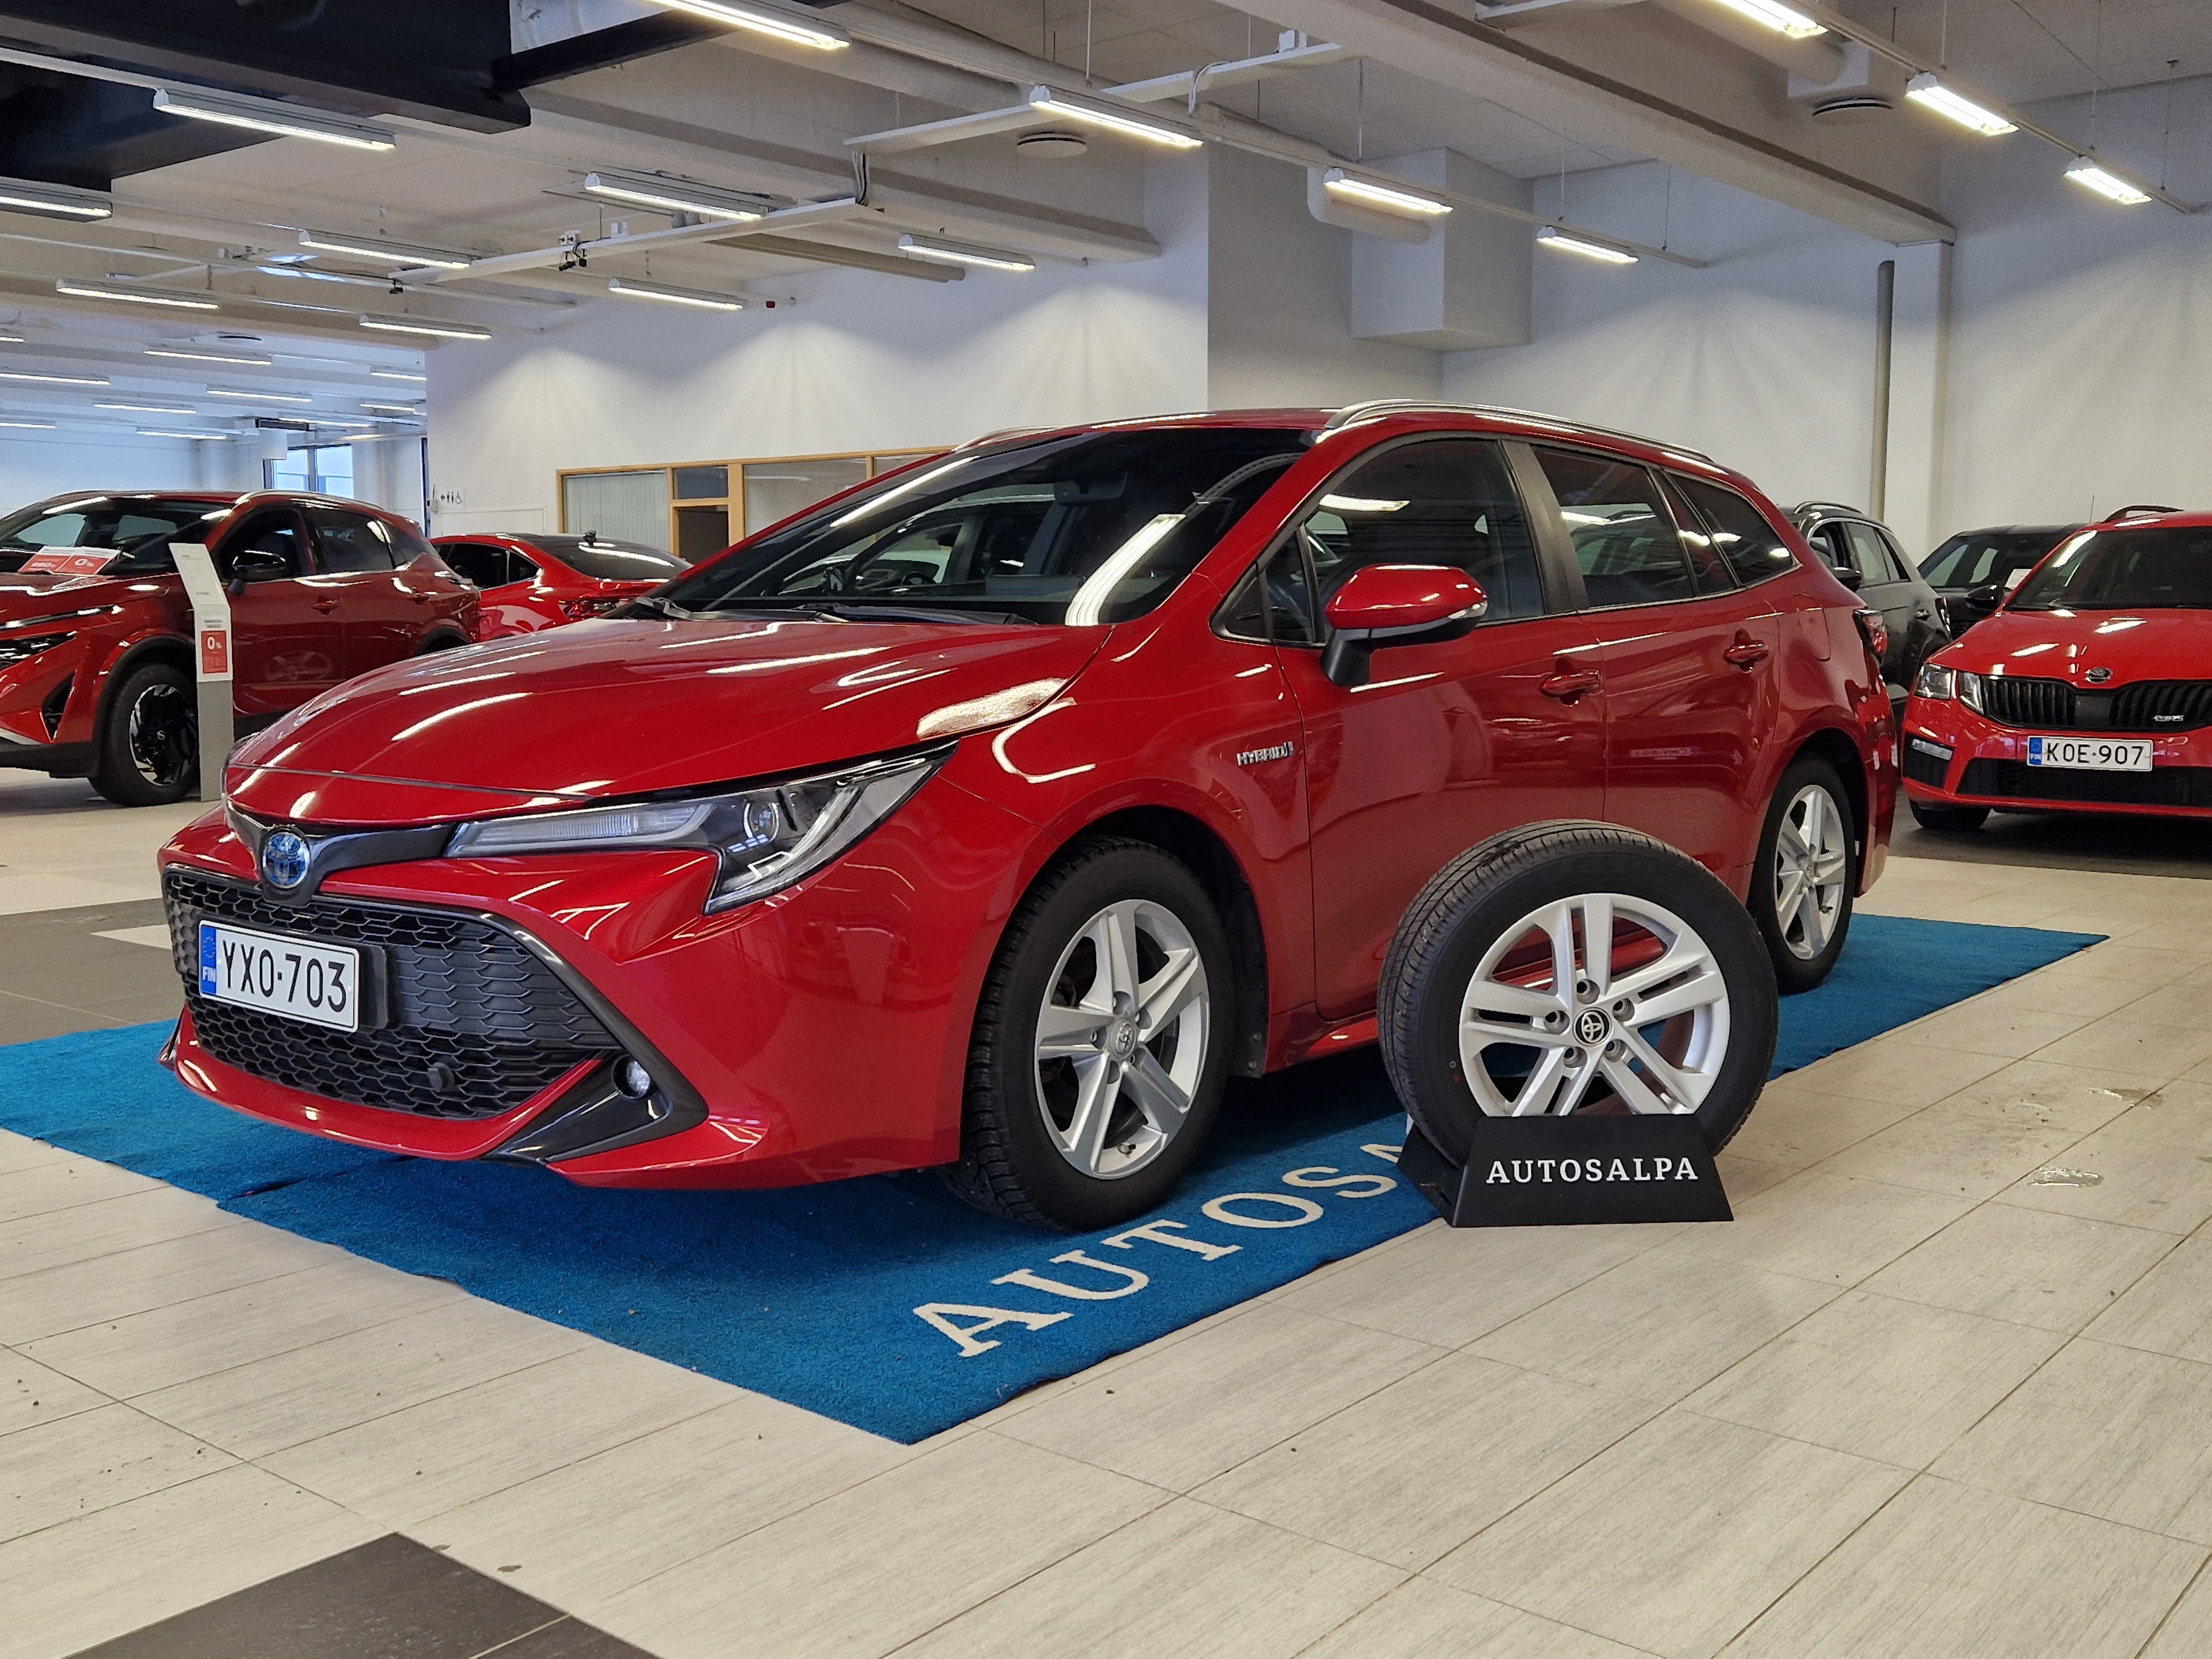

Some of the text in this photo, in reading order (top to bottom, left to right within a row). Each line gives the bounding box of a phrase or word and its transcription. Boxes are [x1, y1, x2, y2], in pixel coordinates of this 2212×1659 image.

[1237, 746, 1286, 766] HYBRID
[2047, 743, 2145, 765] KOE-907
[202, 966, 216, 983] FIN
[222, 940, 346, 1012] YXO-703
[1486, 1157, 1699, 1184] AUTOSALPA
